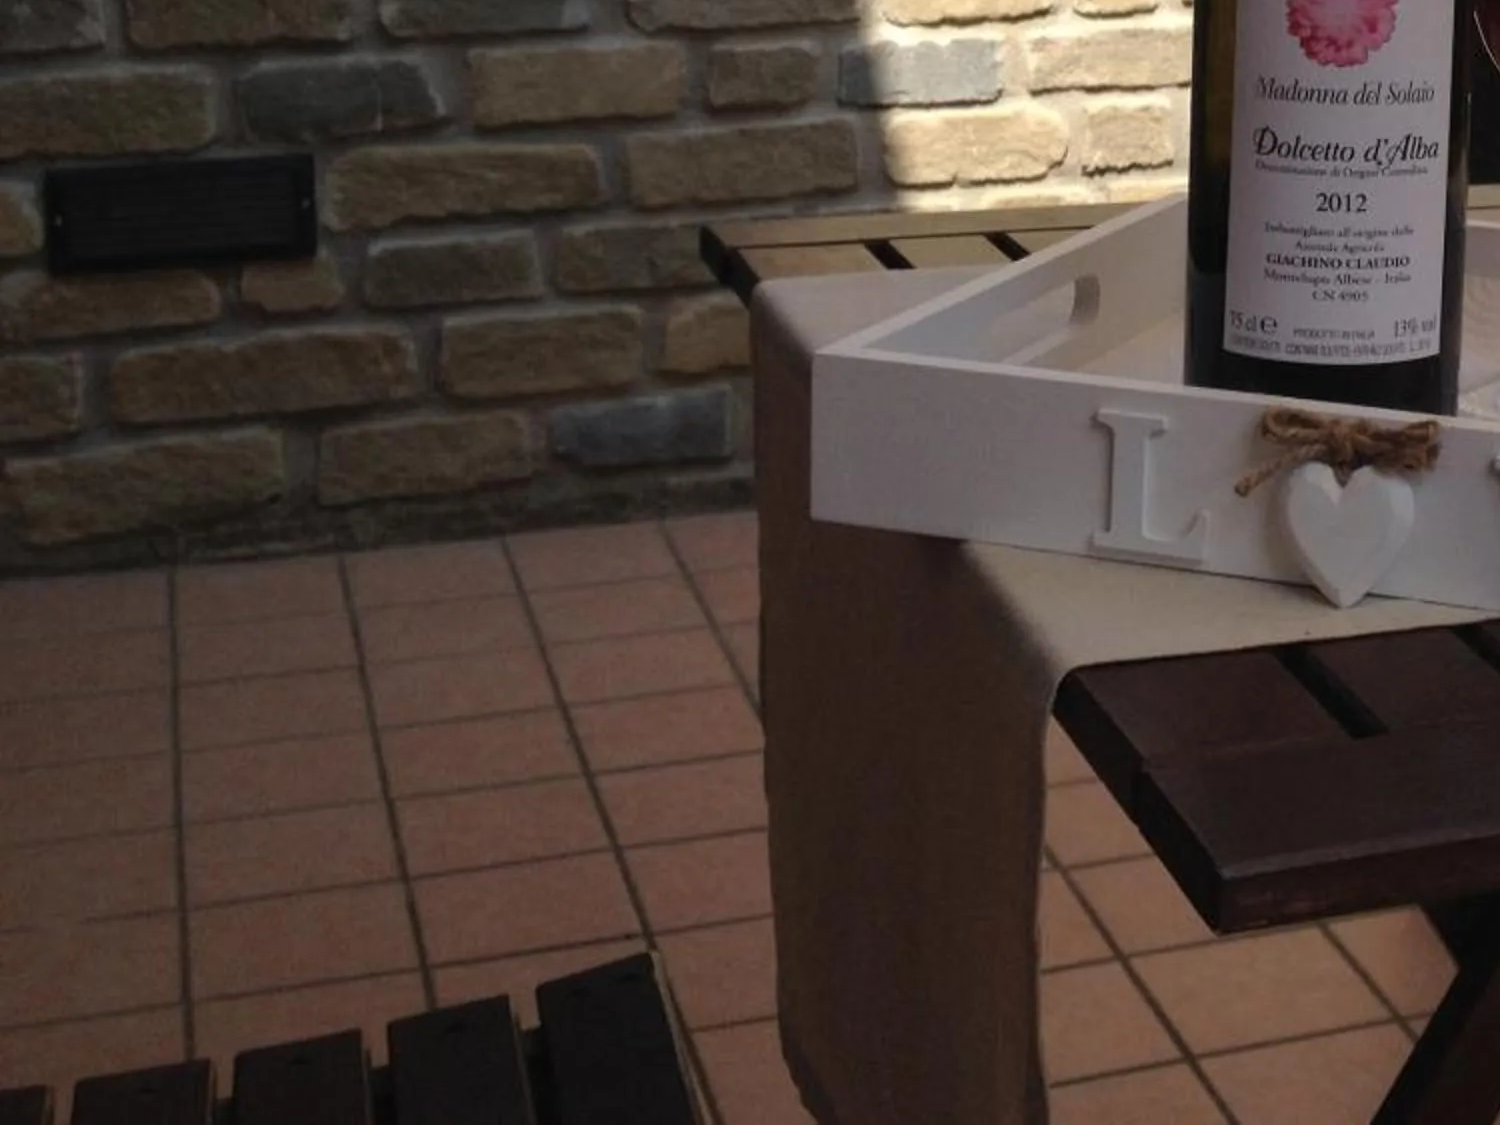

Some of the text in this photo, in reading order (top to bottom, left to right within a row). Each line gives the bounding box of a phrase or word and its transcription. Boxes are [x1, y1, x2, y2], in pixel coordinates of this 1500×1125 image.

[1254, 75, 1435, 105] Madonna del Solaio
[1252, 125, 1439, 171] Dolcetto d'Alba
[1316, 192, 1367, 212] 2012
[1265, 253, 1411, 270] GIACHINO CLAUDIO
[1311, 290, 1336, 302] CN
